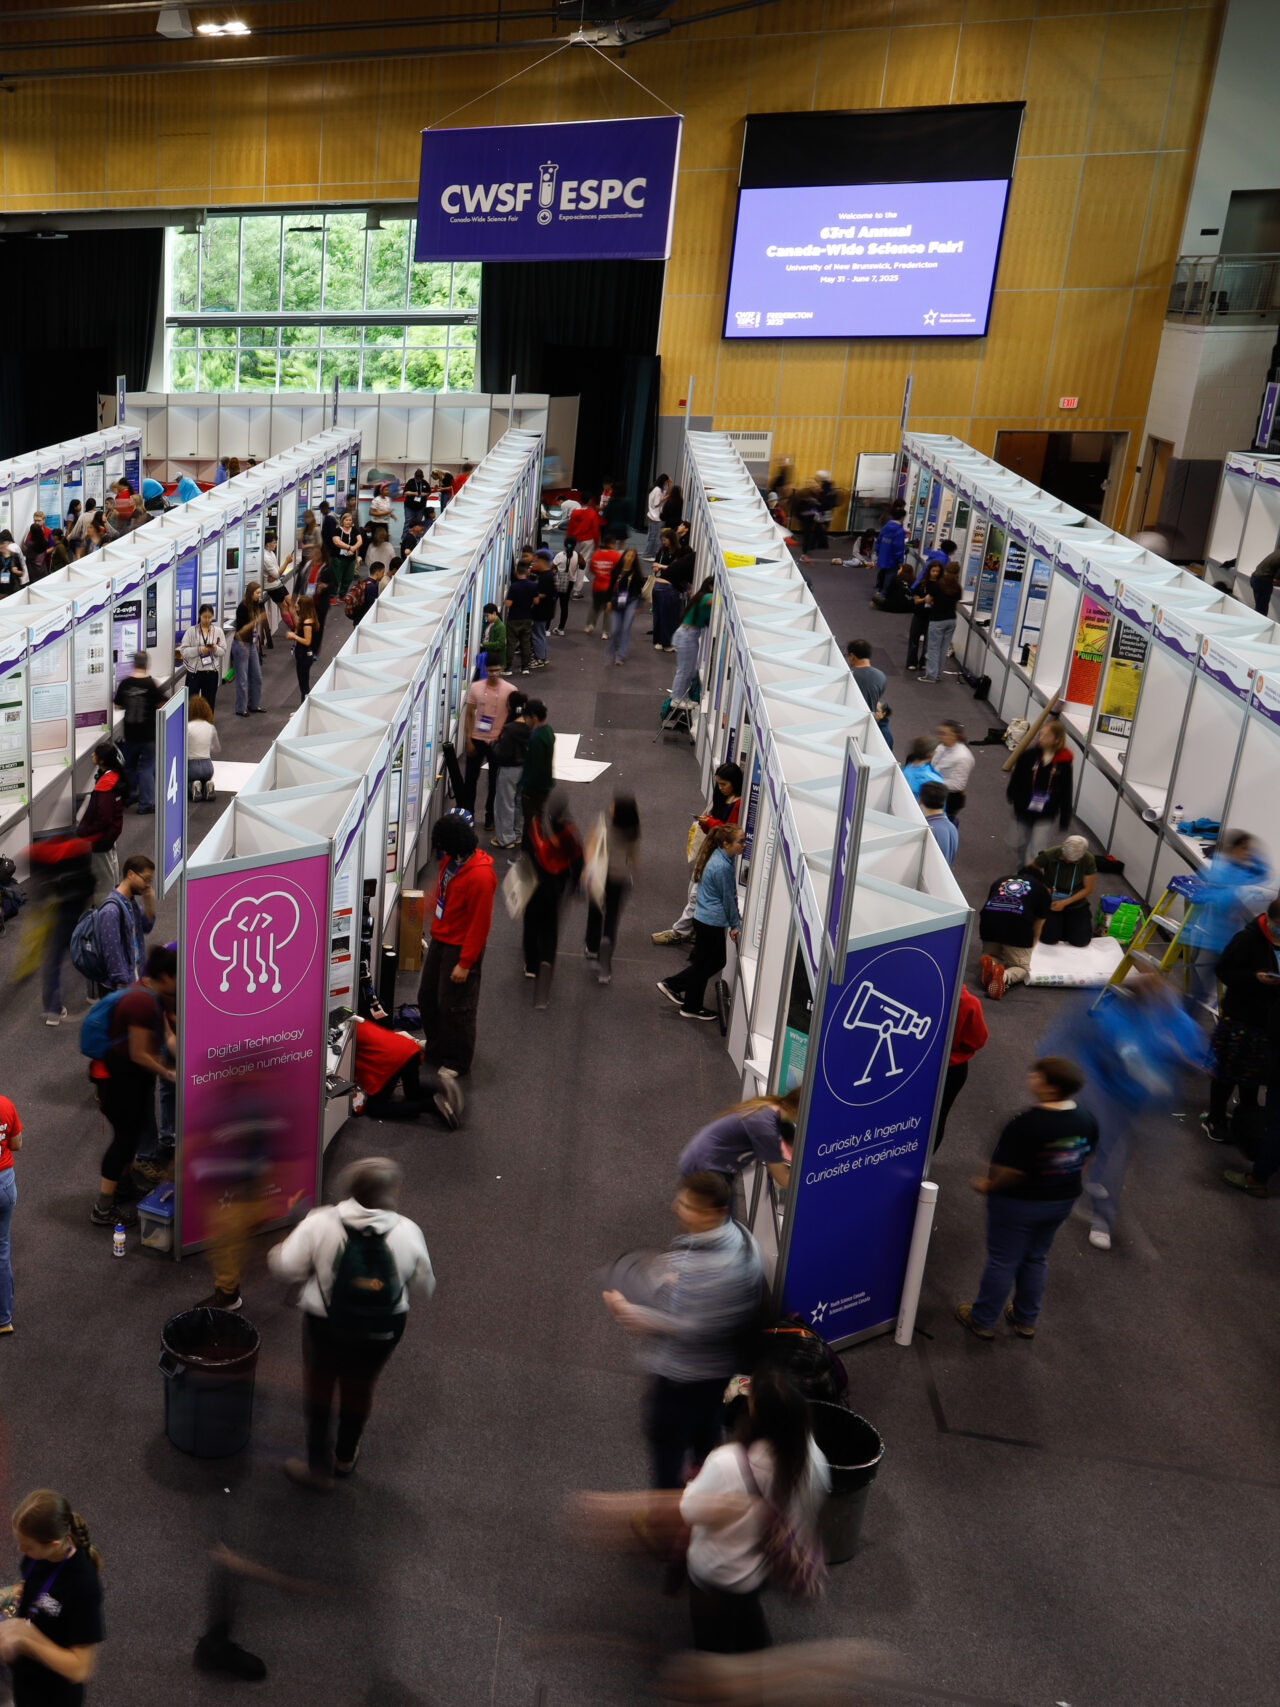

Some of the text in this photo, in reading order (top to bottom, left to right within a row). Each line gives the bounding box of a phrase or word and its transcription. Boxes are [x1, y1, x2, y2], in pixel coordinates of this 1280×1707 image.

[440, 177, 647, 214] CWSF ESPC
[885, 211, 897, 219] the
[819, 224, 912, 239] 63rd Annual
[766, 240, 964, 257] Canada-Wide Science Fair!
[786, 264, 822, 272] University
[824, 263, 832, 271] of
[894, 261, 938, 269] Fredericton
[820, 276, 835, 284] May
[852, 275, 869, 283] June
[879, 274, 899, 282] 2025
[166, 756, 178, 804] 4
[207, 1028, 305, 1059] Digital Technology
[789, 1031, 808, 1043] Why?
[191, 1048, 313, 1086] Technologie numérique
[817, 1117, 921, 1157] Curiosity & Ingenuity
[805, 1138, 919, 1185] Curiosité et ingéniosité
